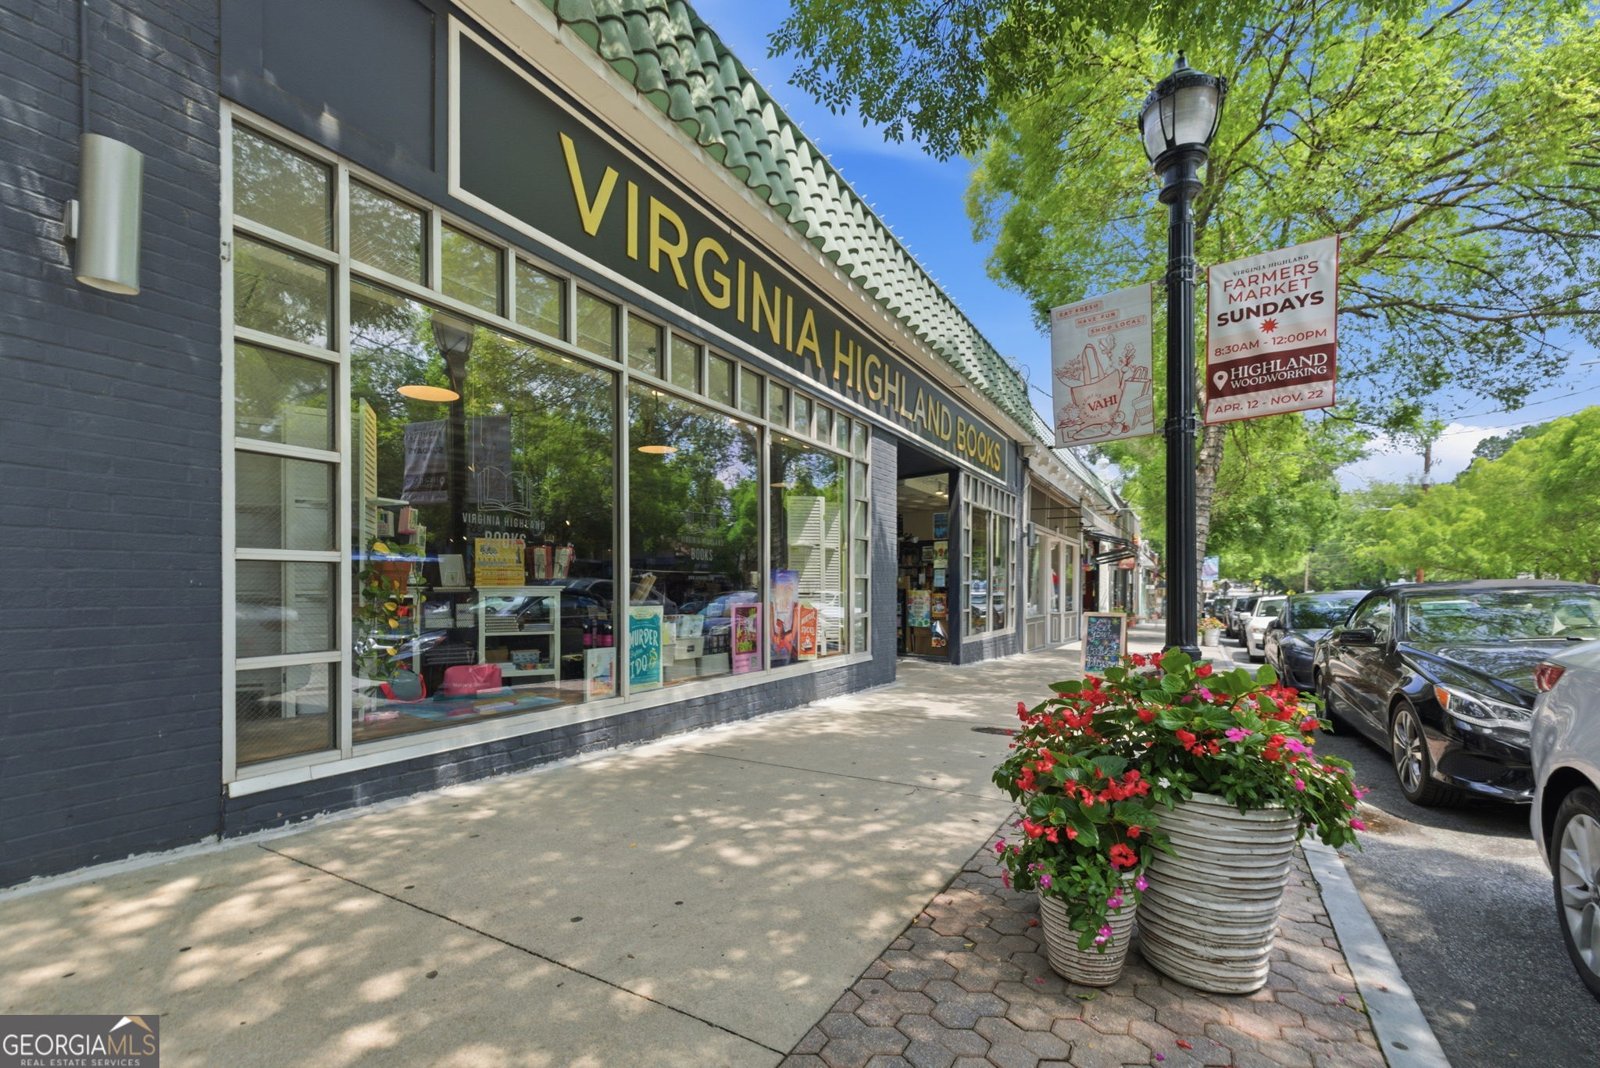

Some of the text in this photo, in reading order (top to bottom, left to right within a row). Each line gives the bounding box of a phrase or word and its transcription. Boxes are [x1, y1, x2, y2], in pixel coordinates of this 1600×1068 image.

[1223, 261, 1319, 292] FARMERS
[1233, 255, 1309, 276] VIRGINIA HIGHLAND
[560, 132, 1001, 472] VIRGINIA HIGHLAND BOOKS
[1228, 277, 1313, 305] MARKET
[1217, 291, 1324, 327] SUNDAYS
[1091, 325, 1112, 334] SHOP
[1214, 339, 1259, 357] 8:30AM
[1272, 328, 1327, 346] 12:00PM
[1230, 353, 1328, 379] HIGHLAND
[1231, 365, 1327, 389] WOODWORKING
[1088, 394, 1118, 411] VAHI
[1214, 403, 1243, 414] APR.
[1247, 400, 1259, 409] 12
[1270, 392, 1303, 406] NOV.
[1307, 389, 1324, 399] 22
[462, 512, 546, 530] VIRGINIA HIGHLAND
[484, 530, 527, 549] BOOKS
[690, 547, 714, 561] BOOKS
